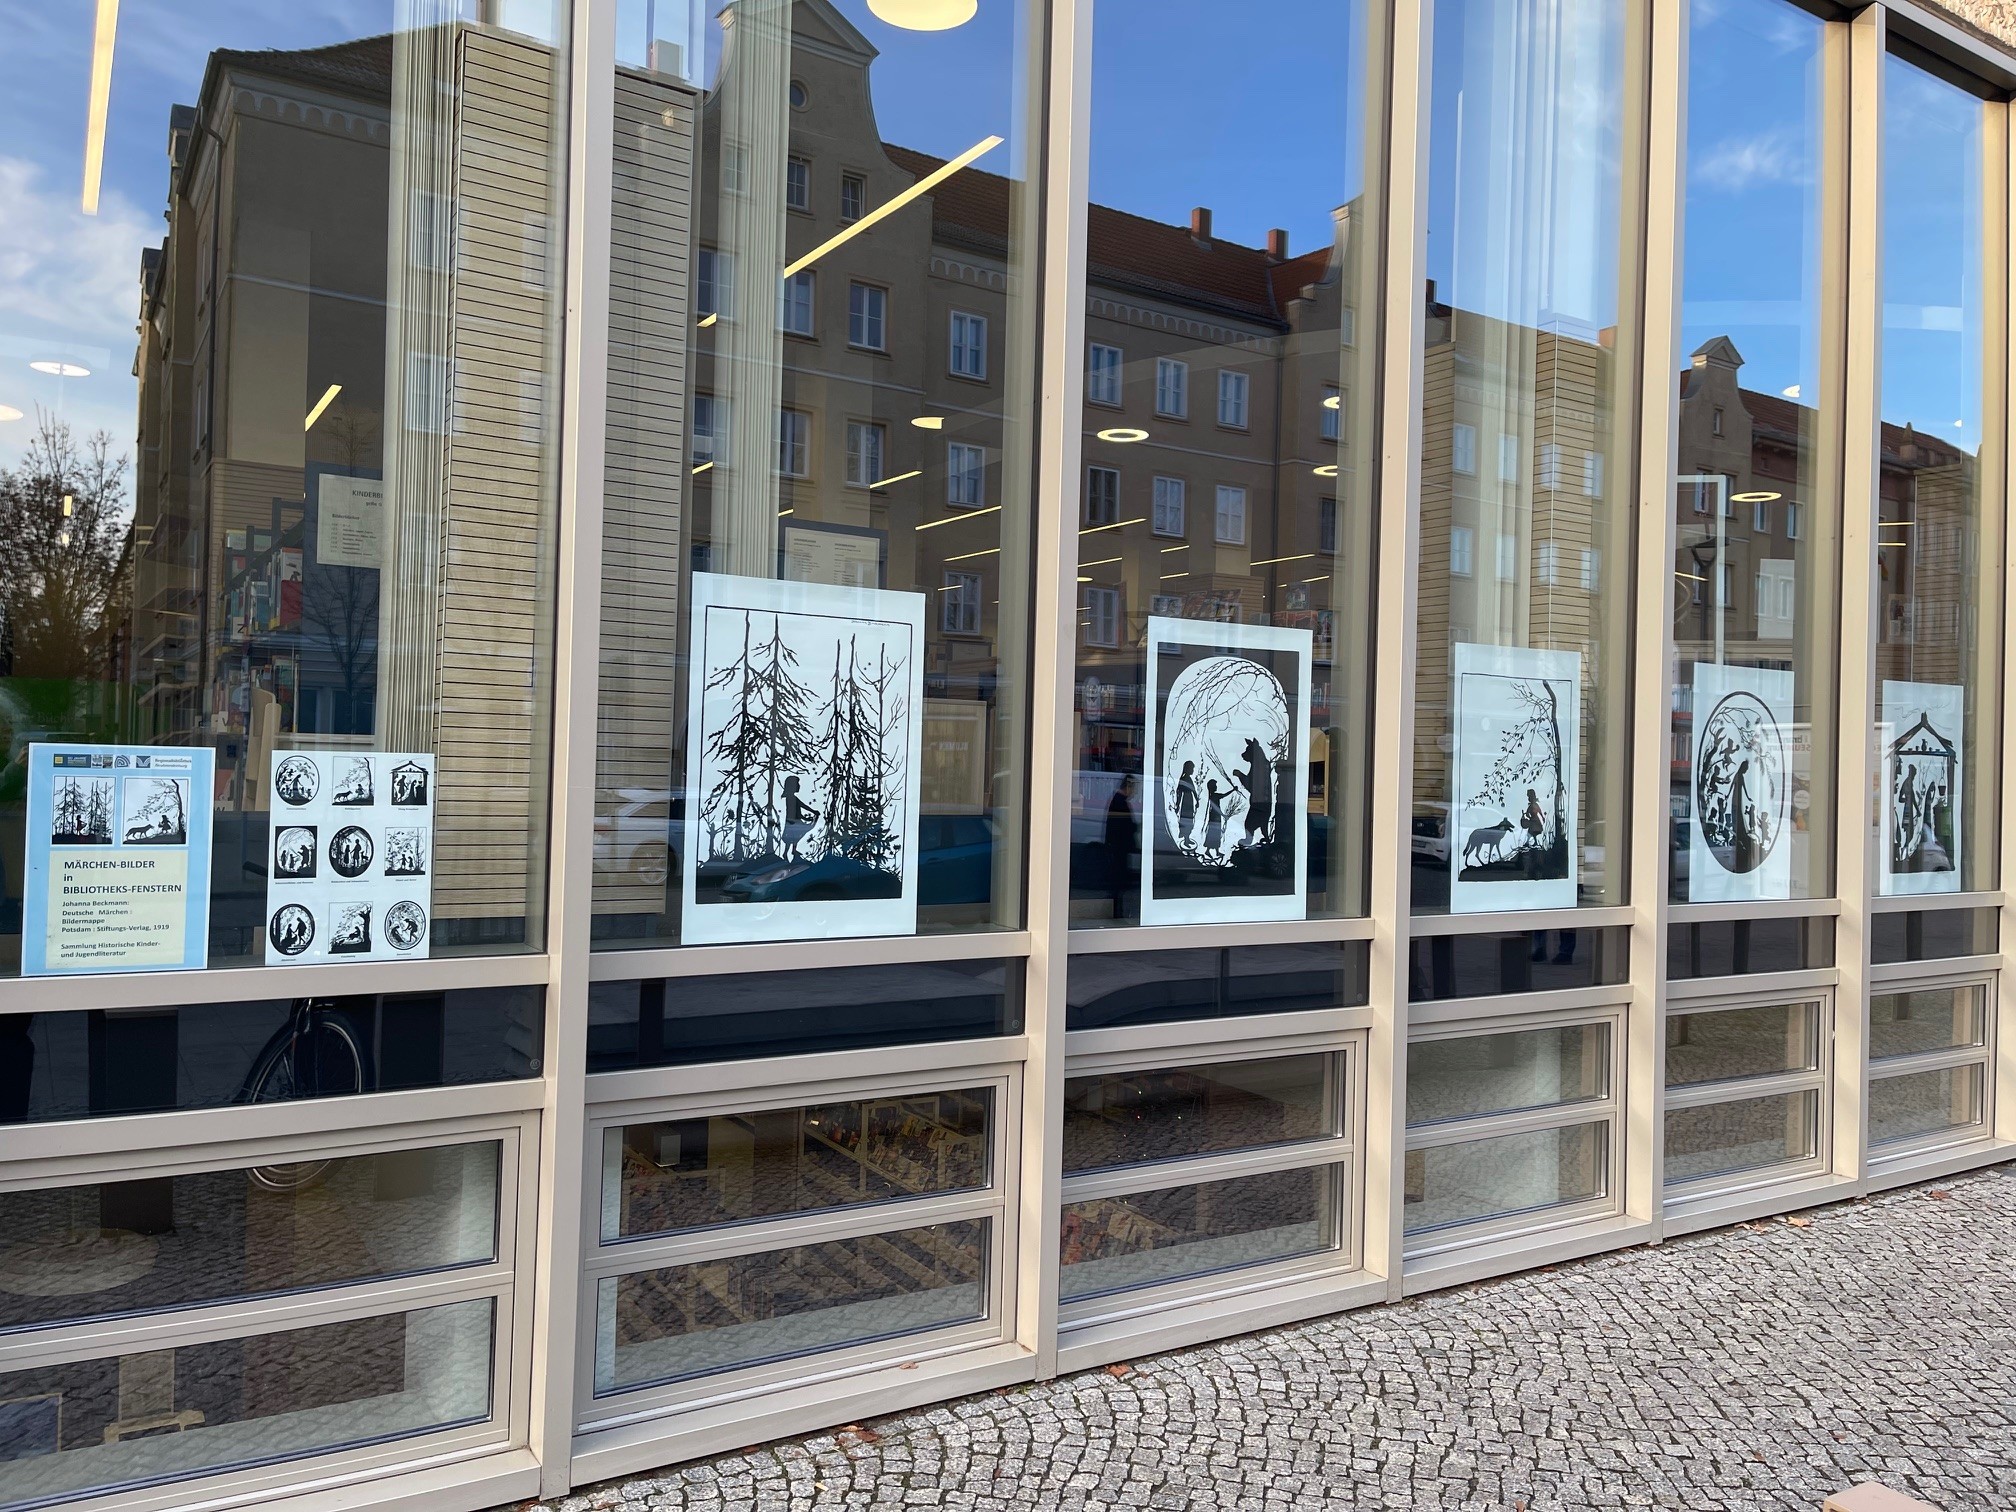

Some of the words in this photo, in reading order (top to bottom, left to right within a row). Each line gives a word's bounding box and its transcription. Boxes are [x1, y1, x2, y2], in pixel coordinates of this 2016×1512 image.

[64, 860, 155, 869] MÄRCHEN-BILDER
[63, 874, 73, 882] in
[63, 885, 182, 894] BIBLIOTHEKS-FENSTERN
[75, 950, 126, 958] Jugendliteratur
